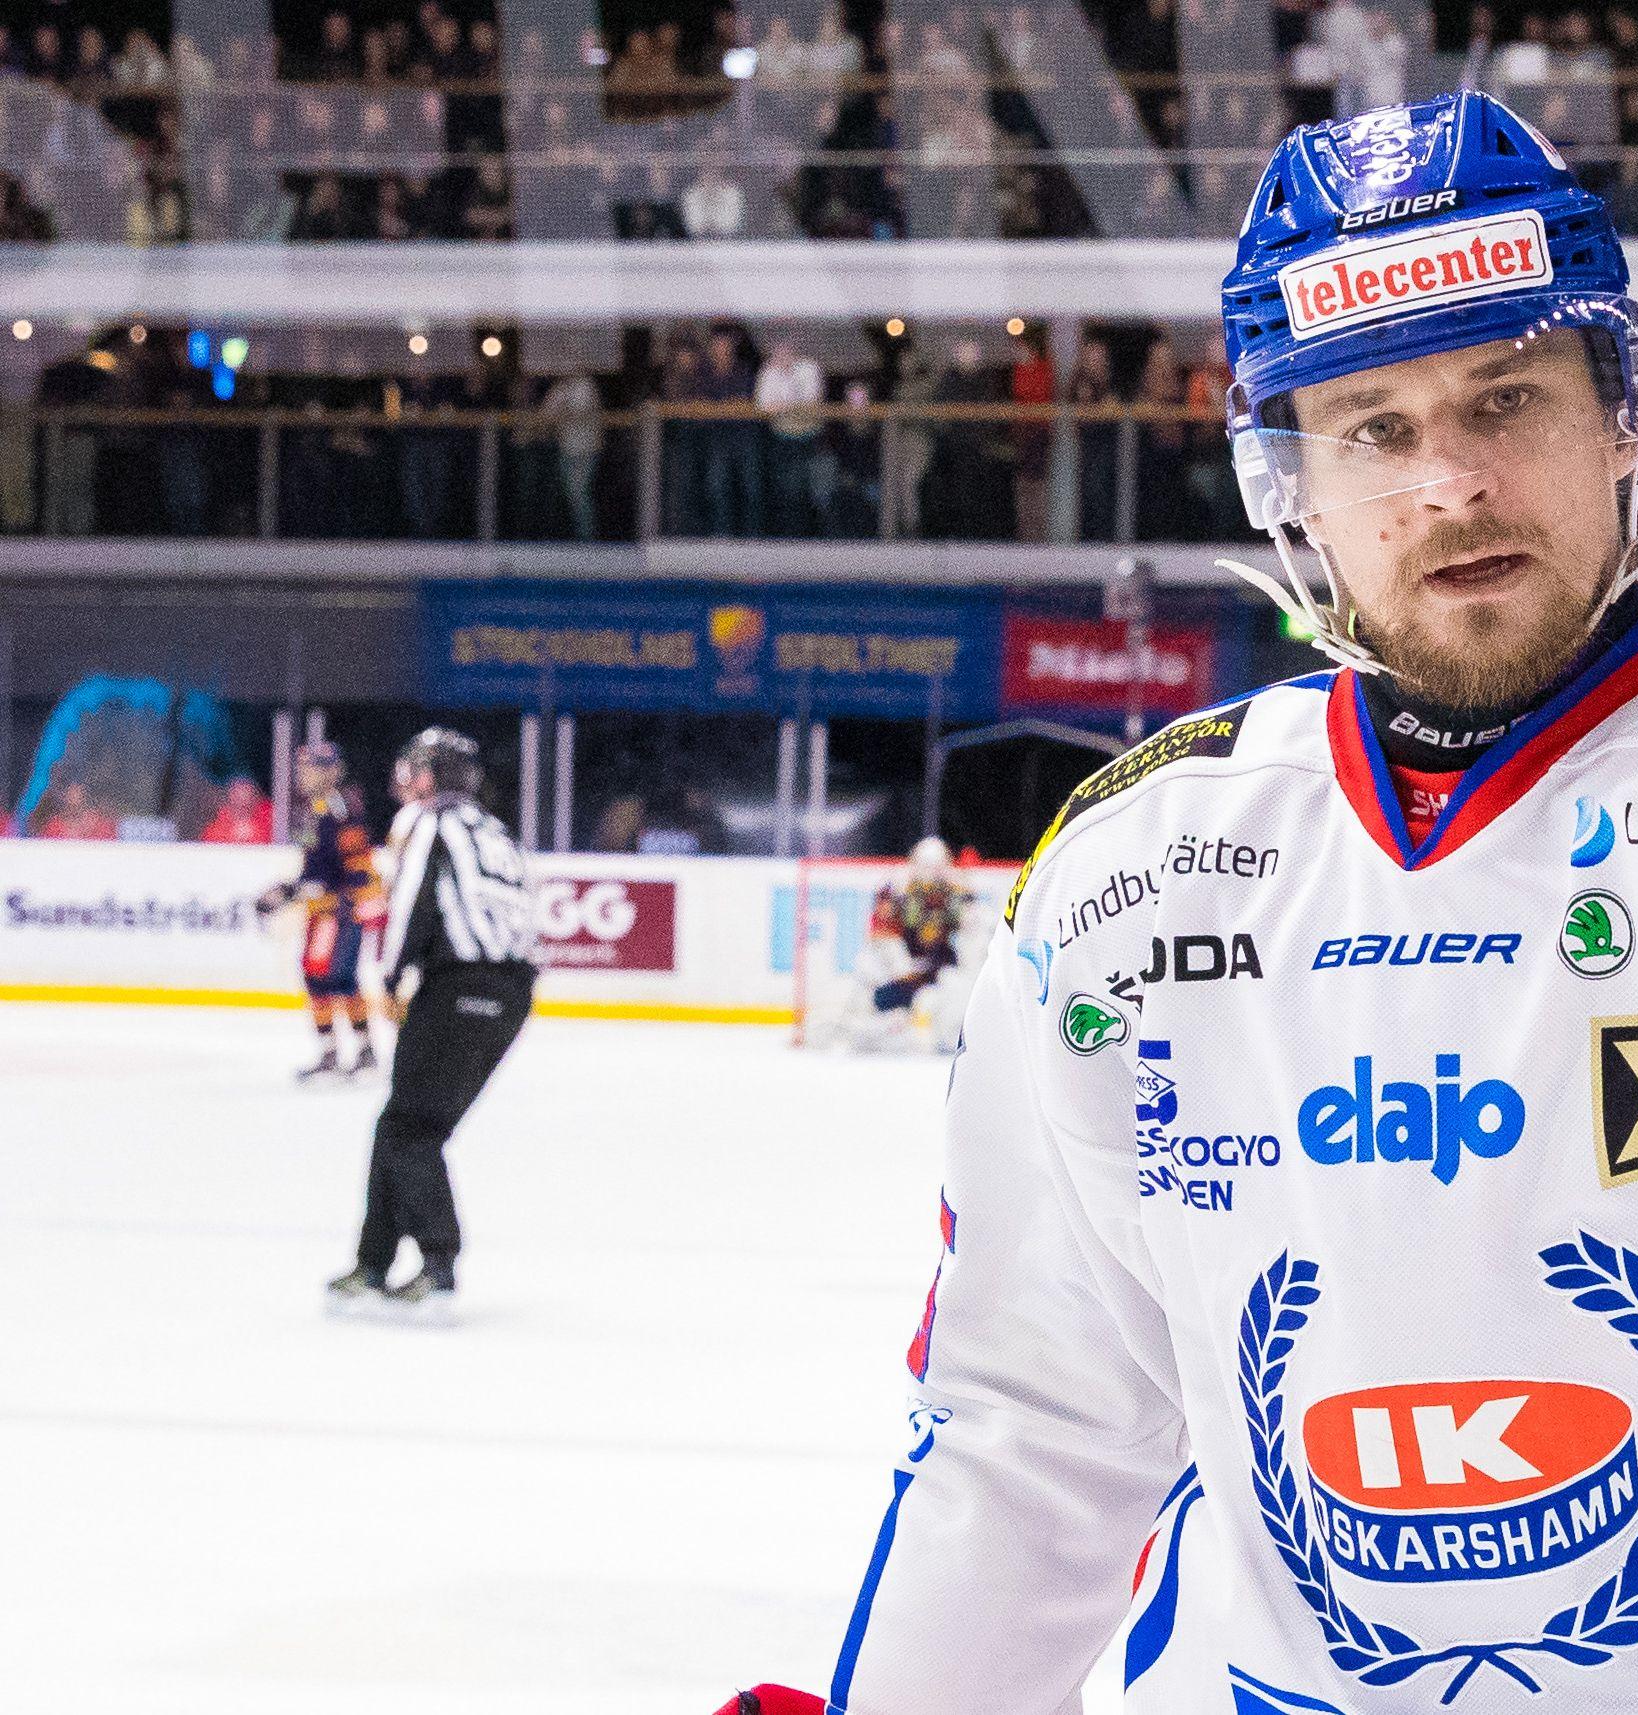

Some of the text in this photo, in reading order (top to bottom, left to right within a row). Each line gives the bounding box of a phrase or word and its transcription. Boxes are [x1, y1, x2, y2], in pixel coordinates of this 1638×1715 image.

[1296, 234, 1535, 322] telecenter
[1057, 833, 1280, 949] Lindbyätten
[1311, 932, 1523, 971] BAUER
[1298, 1054, 1526, 1186] elajo
[1351, 1394, 1545, 1489] IK
[1312, 1461, 1638, 1572] OSKARSHAMN
